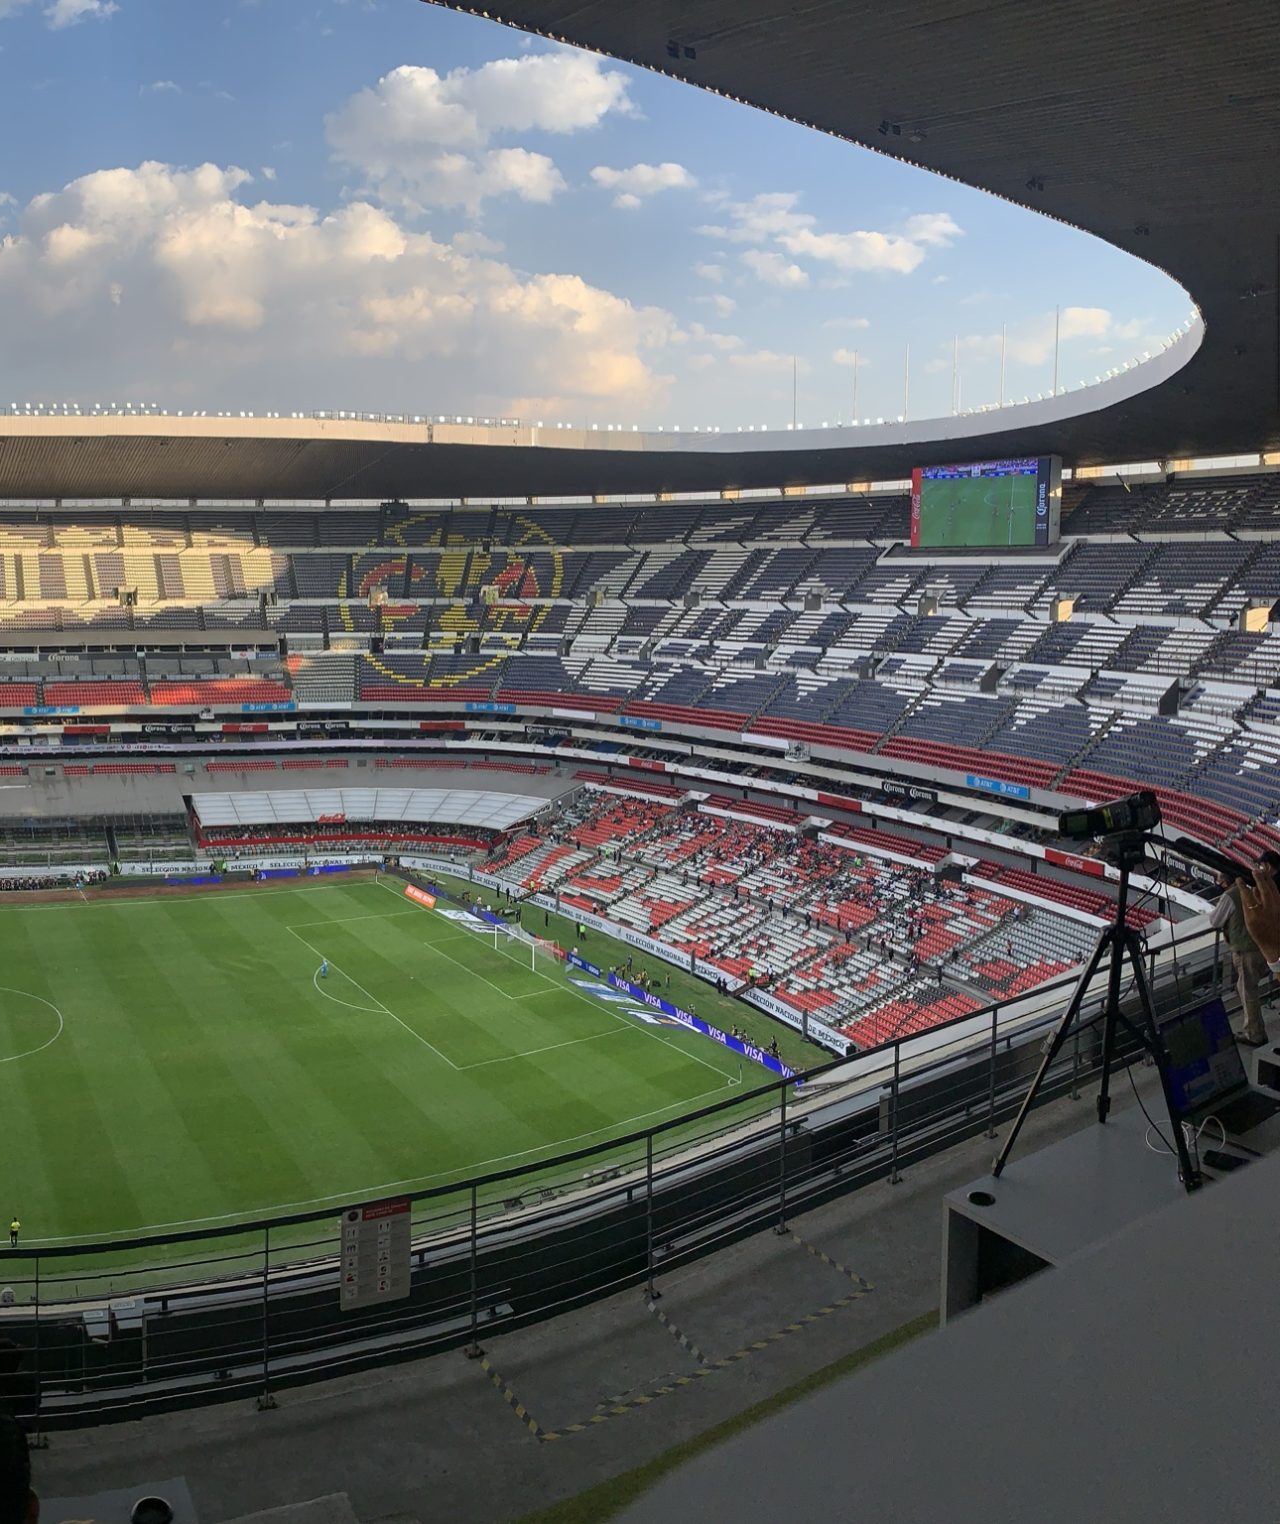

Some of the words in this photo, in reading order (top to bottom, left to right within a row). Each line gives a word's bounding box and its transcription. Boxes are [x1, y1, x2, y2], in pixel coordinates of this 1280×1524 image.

[1036, 483, 1048, 516] Corona
[883, 782, 905, 795] Corona
[909, 787, 933, 800] Corona
[979, 780, 993, 788] AT&T
[1006, 784, 1020, 794] AT&T
[1190, 865, 1216, 884] Corona
[656, 946, 685, 964] NACIONAL
[745, 989, 774, 1010] ELECCIÓN
[775, 1006, 803, 1025] NACIONA
[615, 976, 630, 993] VISA
[644, 991, 661, 1009] VISA
[675, 1007, 693, 1026] VISA
[707, 1024, 727, 1044] VISA
[743, 1042, 764, 1064] VISA
